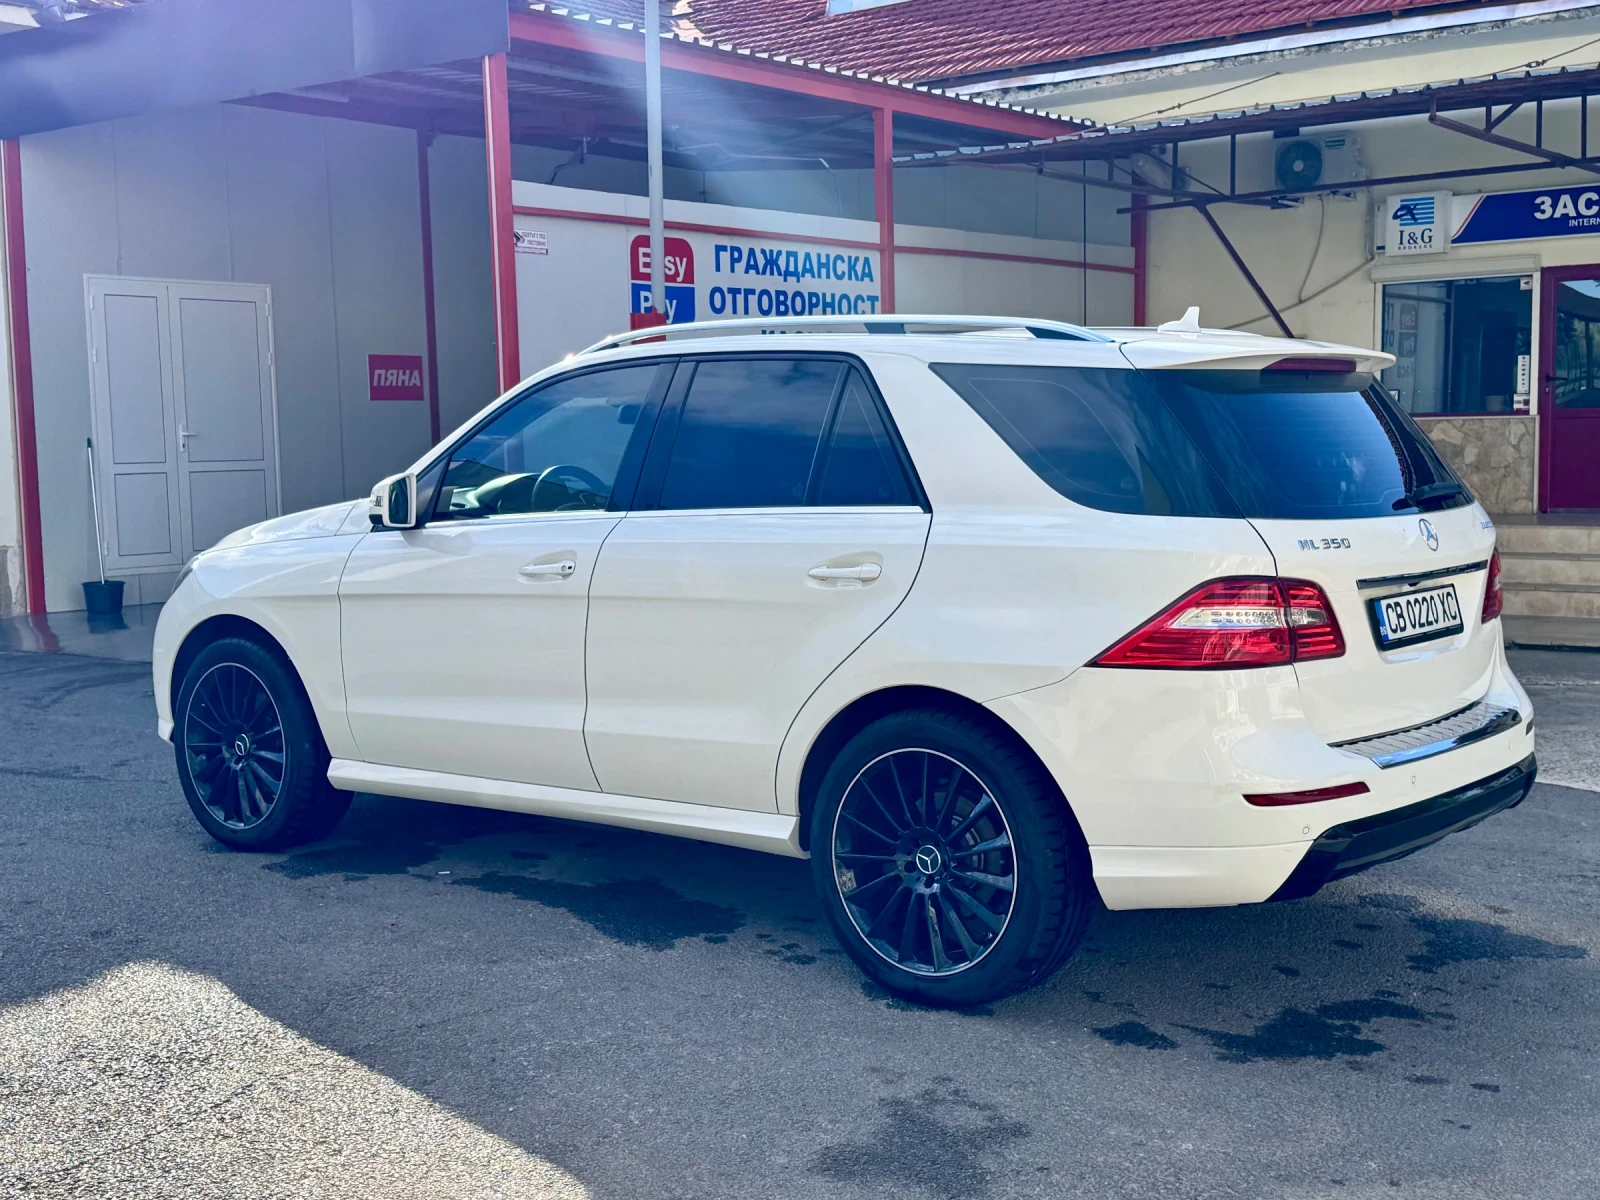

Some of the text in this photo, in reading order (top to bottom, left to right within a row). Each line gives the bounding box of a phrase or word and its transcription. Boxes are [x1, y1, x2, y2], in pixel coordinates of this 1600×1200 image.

[1533, 192, 1600, 220] ЗАС
[638, 247, 688, 283] Esy
[714, 244, 874, 283] ГРАЖДАНСКА
[639, 290, 677, 325] Py
[709, 286, 879, 317] ОТГОВОРНОСТ
[373, 369, 421, 387] ПЯНА
[1298, 538, 1351, 551] ML 350
[1386, 591, 1457, 634] CB 0220 XC
